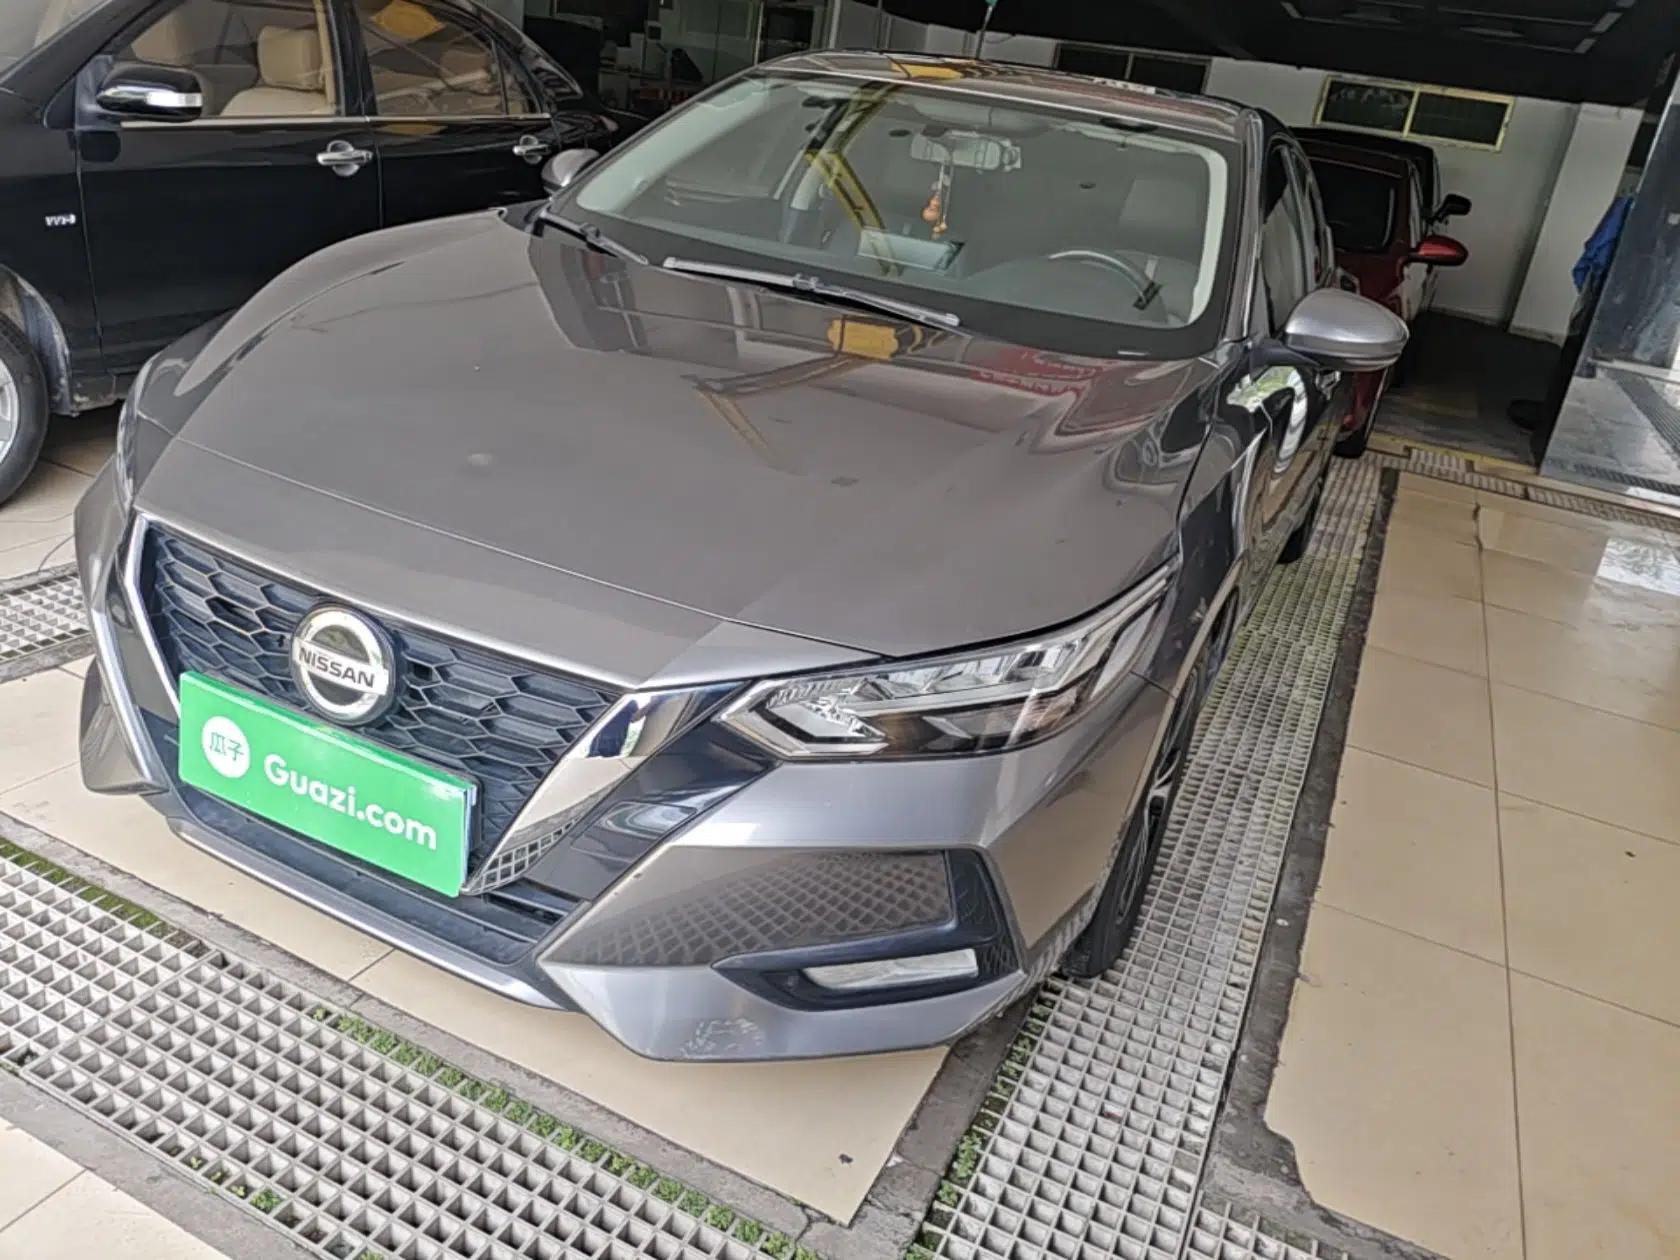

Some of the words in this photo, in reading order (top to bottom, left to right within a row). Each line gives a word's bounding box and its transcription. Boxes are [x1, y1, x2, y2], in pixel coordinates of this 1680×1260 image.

[299, 647, 375, 688] NISSAN
[208, 731, 244, 762] 瓜子
[263, 753, 437, 850] Guazi.com
